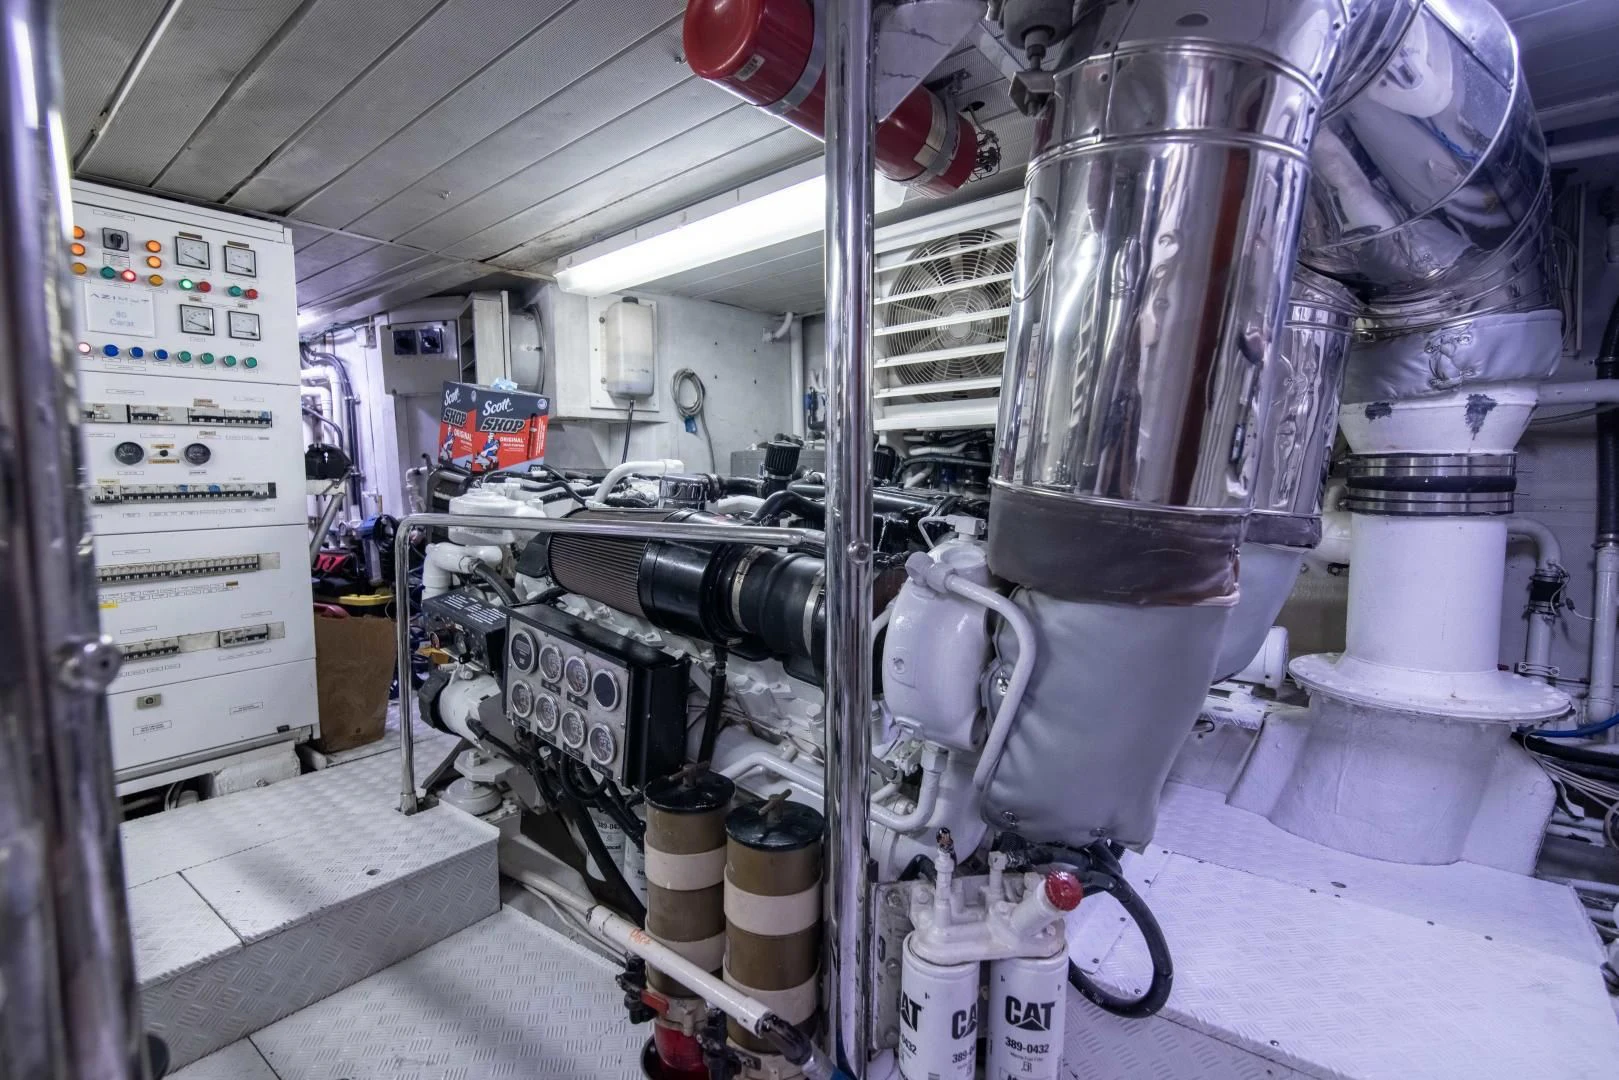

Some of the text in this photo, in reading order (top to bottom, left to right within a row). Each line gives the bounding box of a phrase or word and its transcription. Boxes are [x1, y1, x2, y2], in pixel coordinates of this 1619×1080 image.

[444, 387, 459, 406] Scott
[482, 398, 511, 416] Scott
[442, 407, 467, 427] SHOP
[480, 416, 525, 433] SHOP
[454, 428, 472, 441] ORIGINAL
[901, 988, 923, 1033] AT
[1005, 995, 1056, 1032] CAT
[951, 1002, 978, 1040] CA
[1005, 1036, 1050, 1054] 389-0432
